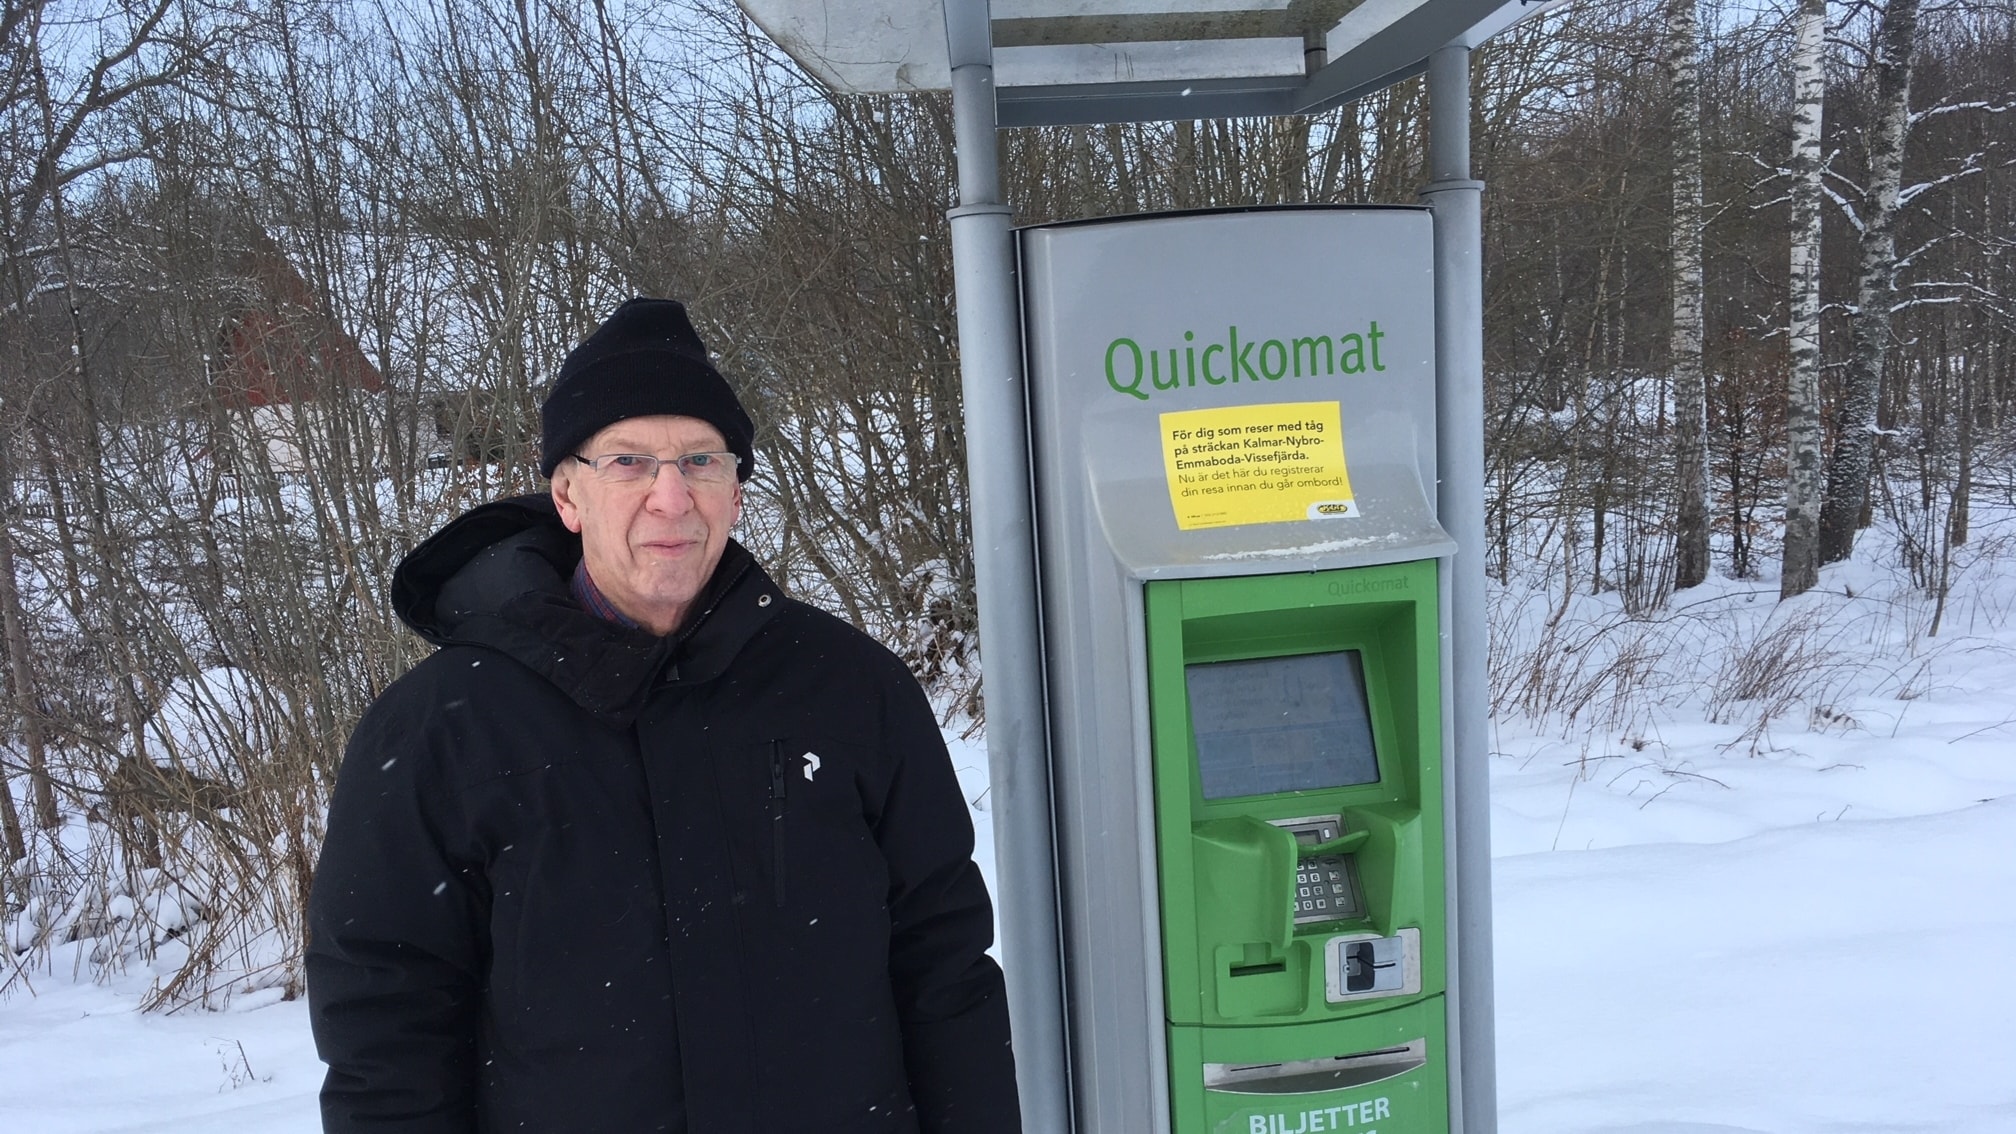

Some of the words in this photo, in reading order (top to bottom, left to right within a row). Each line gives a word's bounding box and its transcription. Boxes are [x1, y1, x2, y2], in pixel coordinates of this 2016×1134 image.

[1104, 320, 1386, 401] Quickomat
[1172, 428, 1192, 440] För
[1196, 427, 1215, 439] dig
[1218, 426, 1241, 437] som
[1245, 423, 1274, 434] reser
[1277, 421, 1302, 432] med
[1305, 420, 1324, 432] tåg
[1174, 446, 1189, 457] på
[1192, 441, 1240, 453] sträckan
[1243, 436, 1324, 450] Kalmar-Nybro-
[1176, 451, 1309, 469] Emmaboda-Vissefjärda.
[1179, 474, 1195, 484] Nu
[1198, 472, 1208, 482] är
[1212, 471, 1230, 480] det
[1233, 469, 1250, 478] här
[1253, 466, 1268, 476] du
[1270, 465, 1324, 477] registrerar
[1181, 487, 1199, 497] din
[1202, 486, 1224, 495] resa
[1227, 483, 1256, 492] innan
[1259, 480, 1273, 490] du
[1277, 479, 1294, 490] går
[1297, 477, 1343, 488] ombord!
[1327, 575, 1410, 597] Quickomat
[1249, 1097, 1391, 1134] BILJETTER
